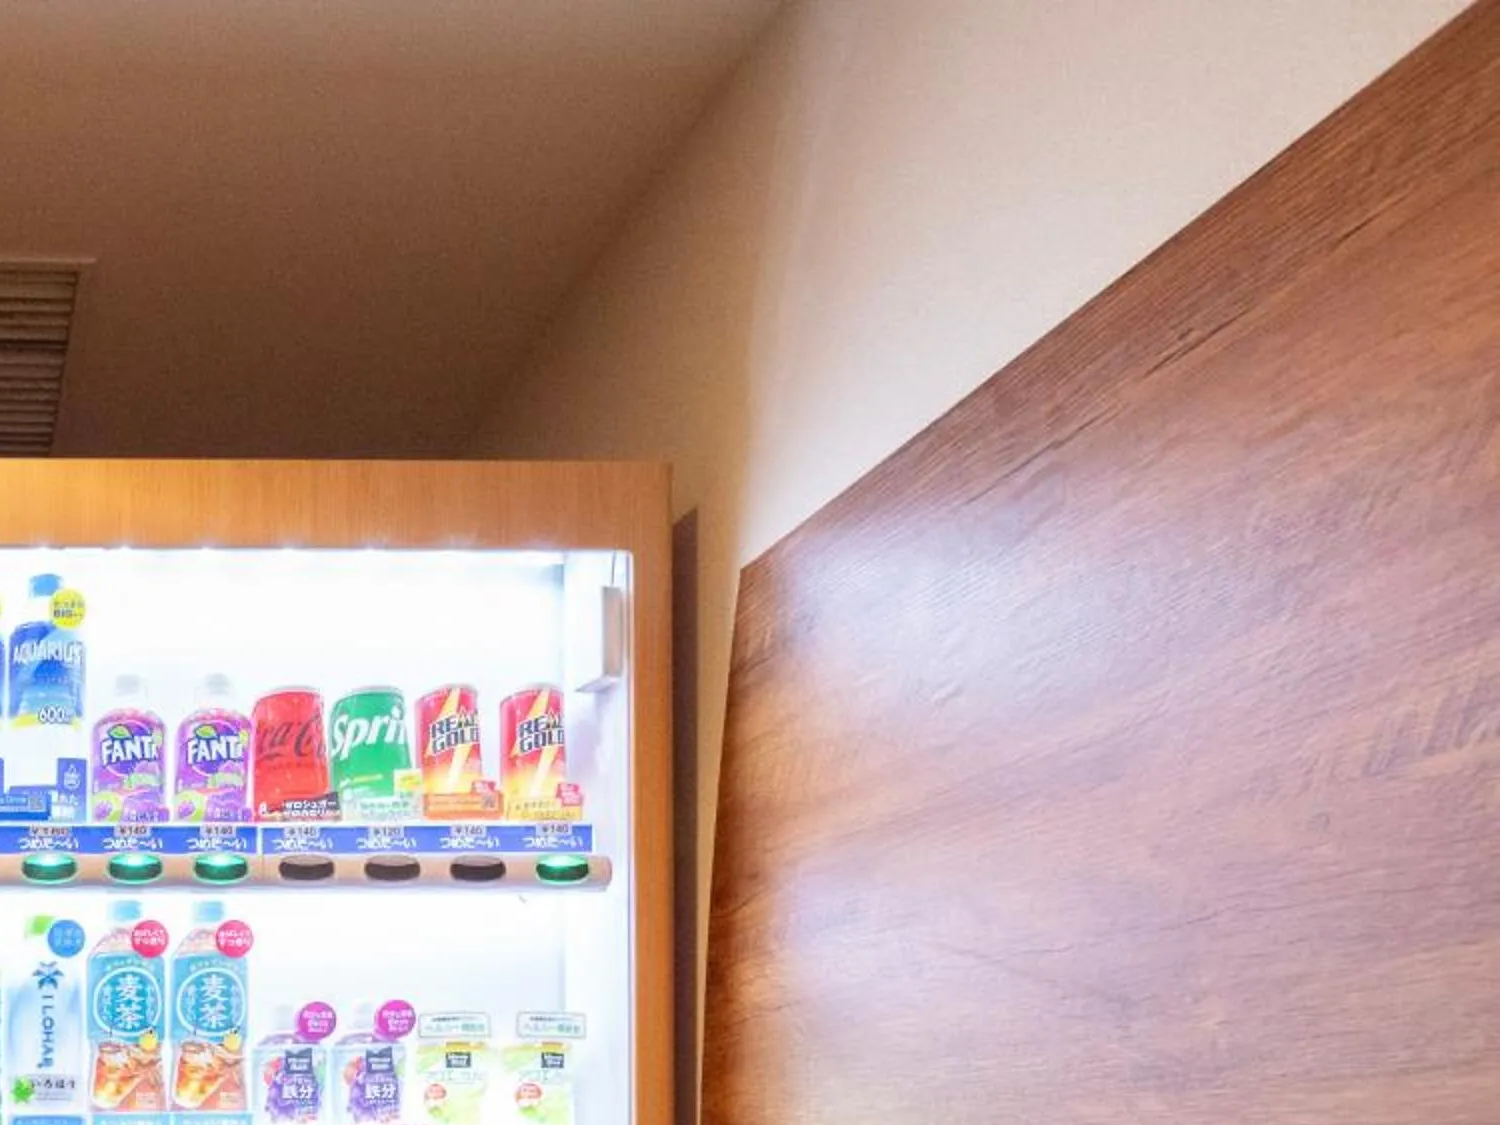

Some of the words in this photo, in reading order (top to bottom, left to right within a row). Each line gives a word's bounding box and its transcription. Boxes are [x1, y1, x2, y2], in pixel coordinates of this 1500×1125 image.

[14, 641, 84, 665] AQUARIUS
[115, 973, 141, 1030] 麦茶
[200, 973, 225, 1030] 麦茶
